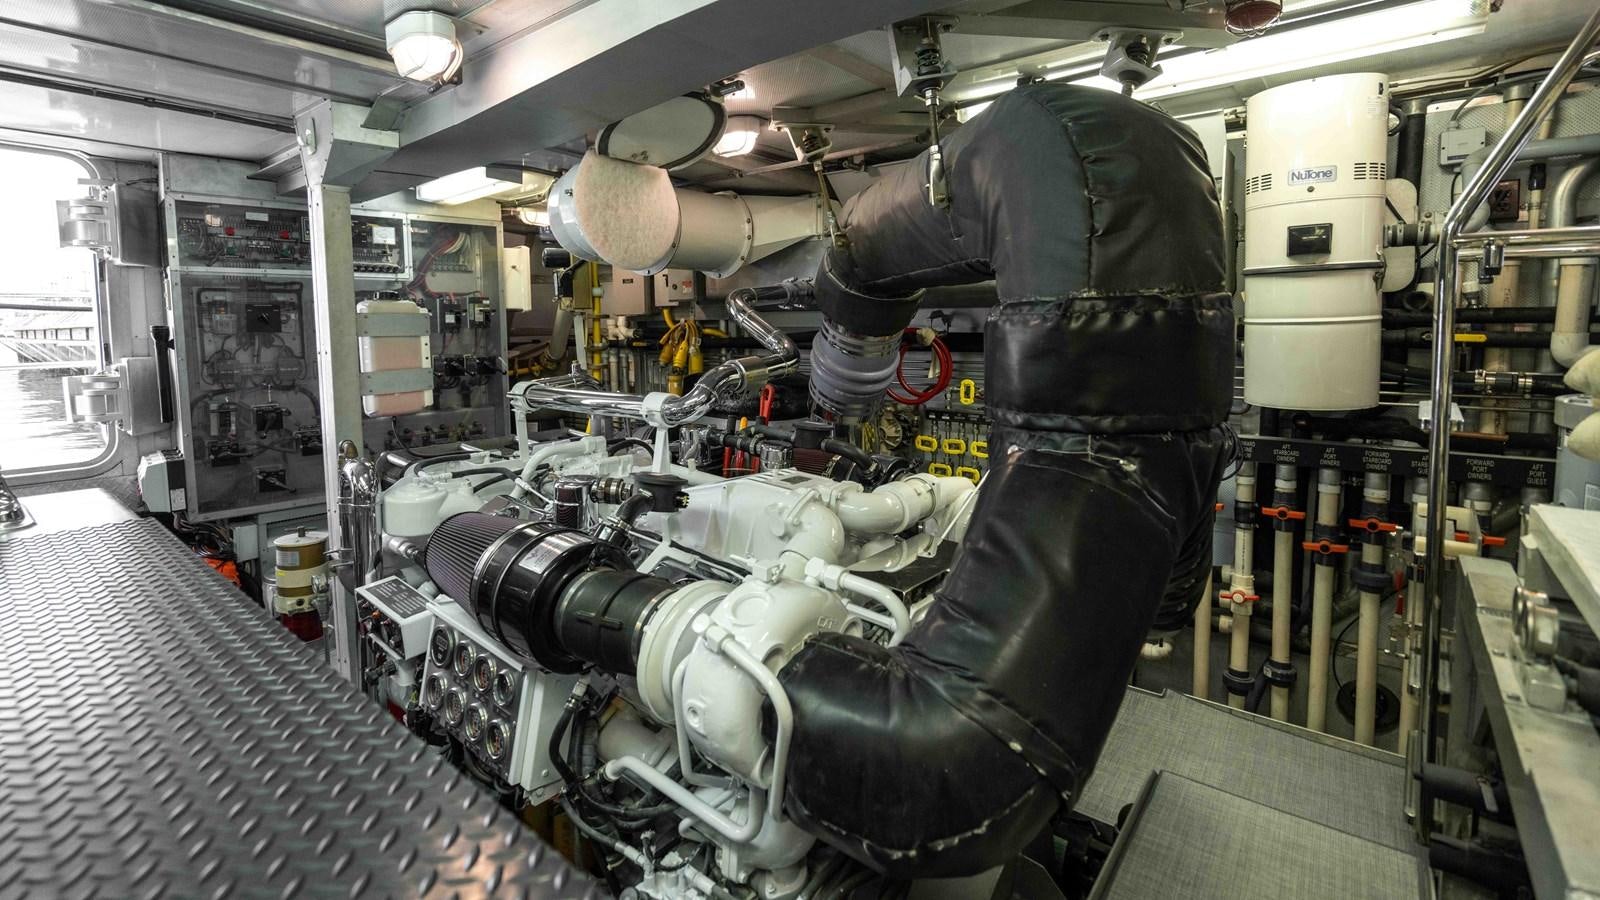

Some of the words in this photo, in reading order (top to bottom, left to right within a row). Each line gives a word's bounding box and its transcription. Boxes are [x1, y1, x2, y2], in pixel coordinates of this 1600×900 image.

[1291, 169, 1333, 182] NuTone
[1273, 449, 1300, 457] STARBOARD
[1365, 450, 1390, 458] FORWARD
[1276, 455, 1296, 463] OWNERS
[1320, 459, 1340, 467] OWNERS
[1362, 456, 1393, 465] STARBOARD
[1466, 458, 1495, 467] FORWARD
[1366, 463, 1388, 471] OWNERS
[1532, 463, 1544, 471] AFT
[1467, 472, 1492, 480] OWNERS
[1529, 470, 1546, 478] PORT
[1527, 477, 1547, 486] GUEST
